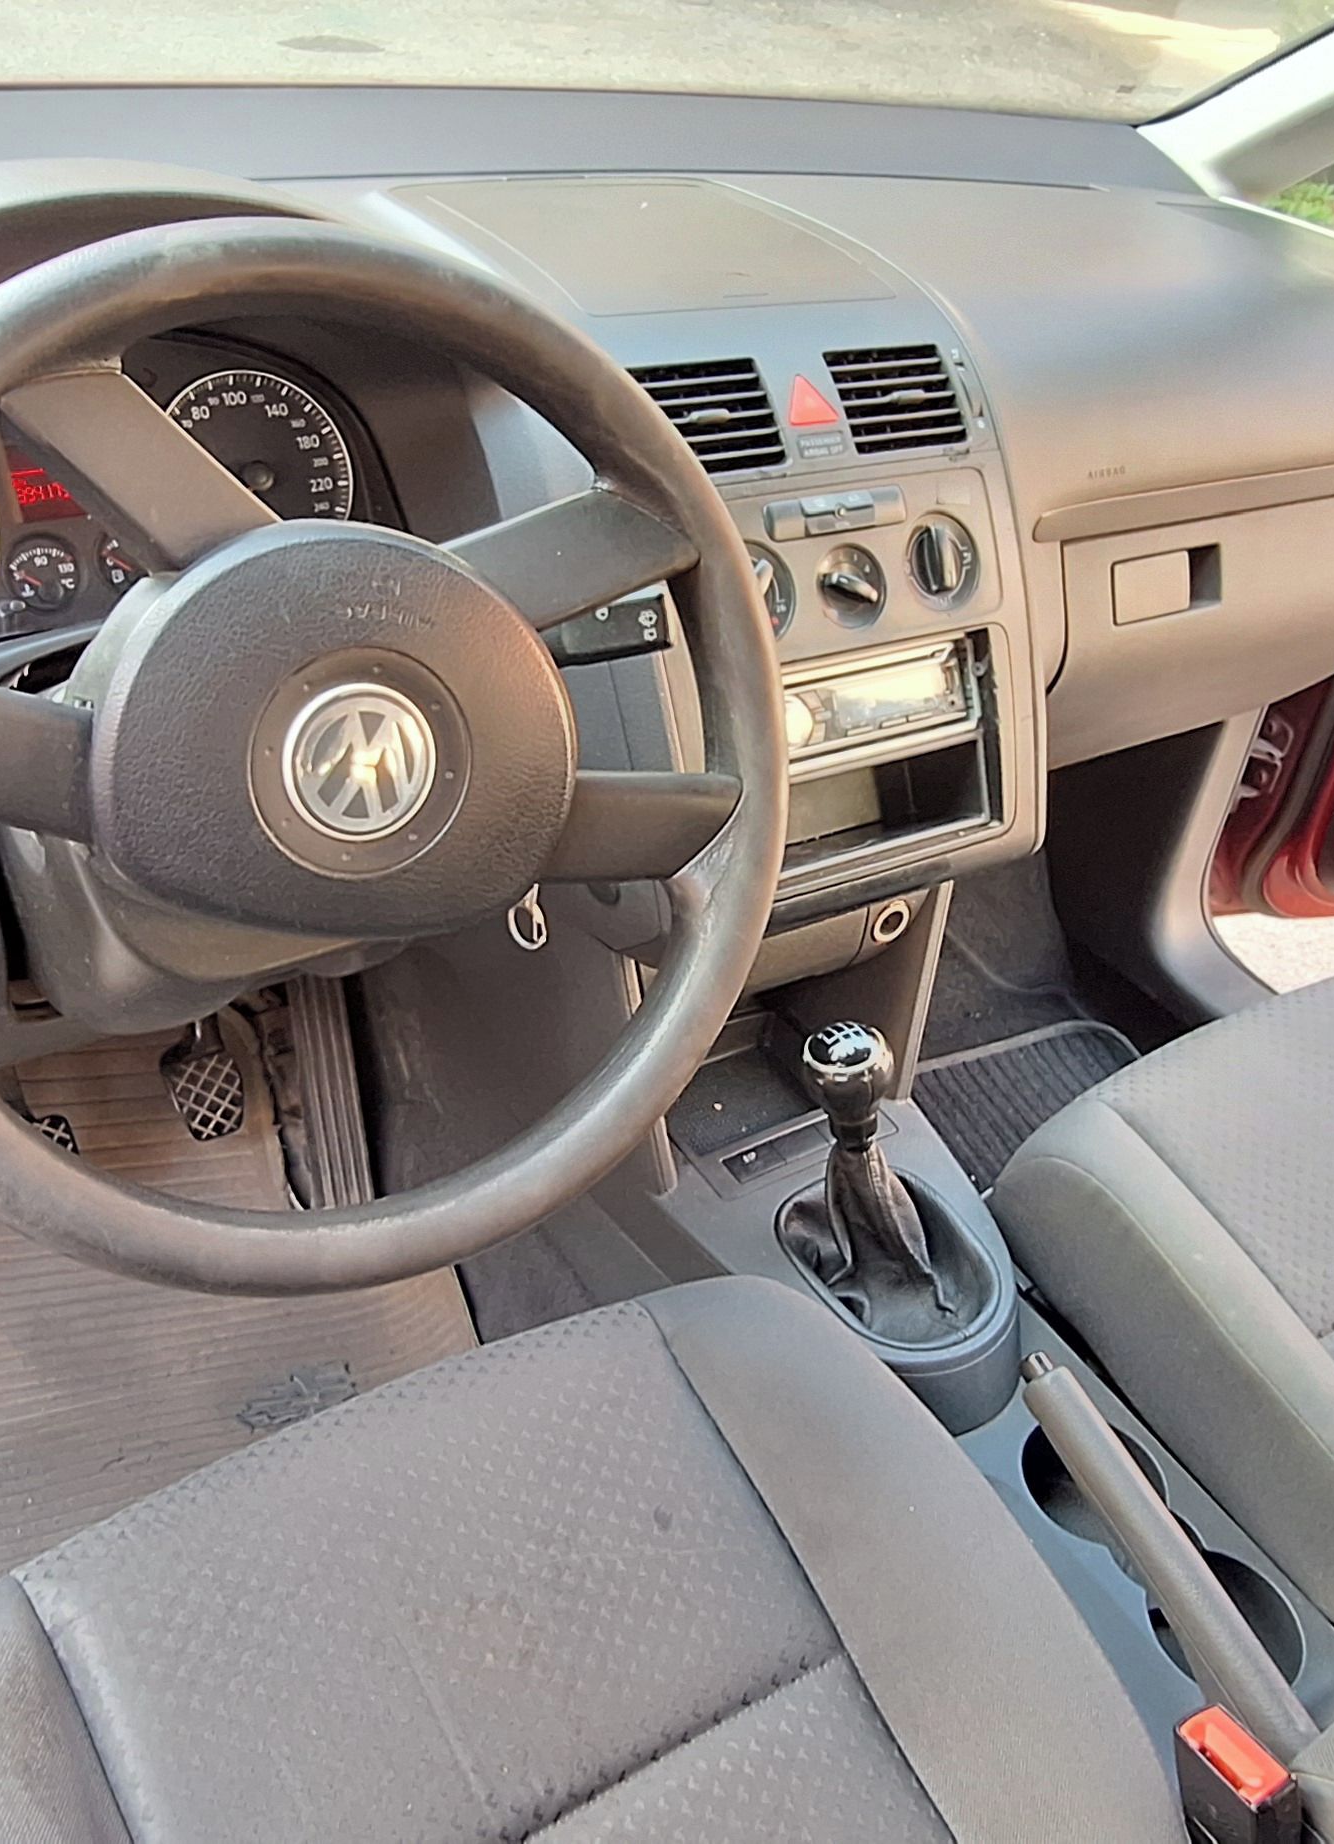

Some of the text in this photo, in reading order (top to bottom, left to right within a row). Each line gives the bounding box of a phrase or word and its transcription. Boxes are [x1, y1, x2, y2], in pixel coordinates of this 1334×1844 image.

[221, 391, 247, 406] 100
[191, 405, 210, 420] 80
[264, 403, 289, 418] 140
[296, 434, 320, 450] 180
[1088, 465, 1126, 479] AIRBAG
[309, 477, 333, 493] 220
[34, 555, 48, 567] 90
